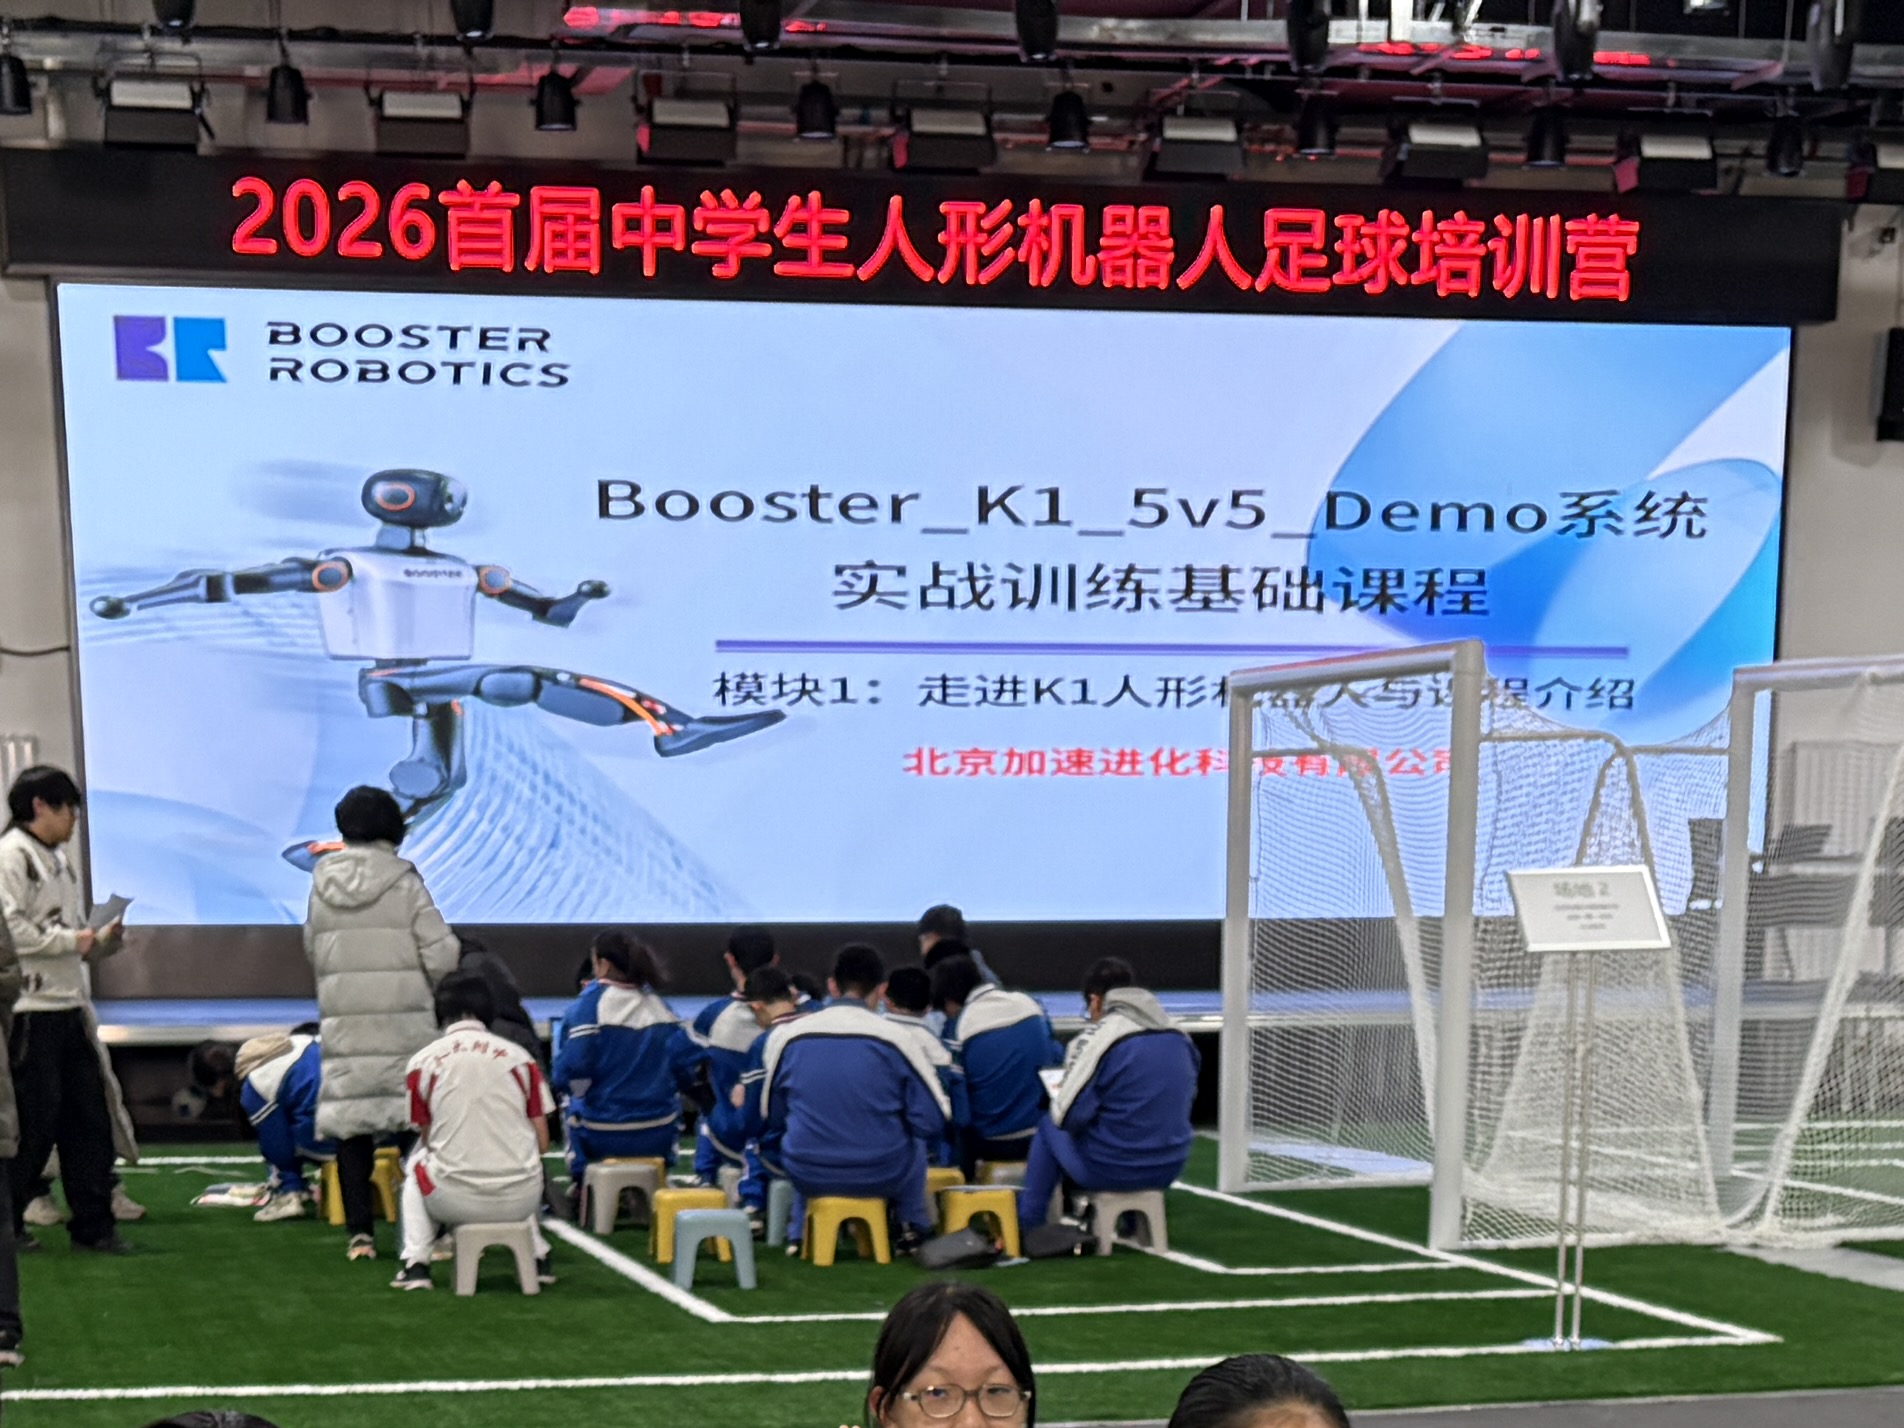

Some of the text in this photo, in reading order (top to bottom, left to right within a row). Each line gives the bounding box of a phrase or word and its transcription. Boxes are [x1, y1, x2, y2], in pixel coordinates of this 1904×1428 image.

[231, 176, 1640, 301] 2026首届中学生人形机器人足球培训营
[266, 320, 552, 353] BOOSTER
[269, 357, 572, 388] ROBOTICS
[597, 479, 1709, 539] Booster_K1_5v5_Demo系统
[833, 560, 1489, 616] 实战训练基础课程
